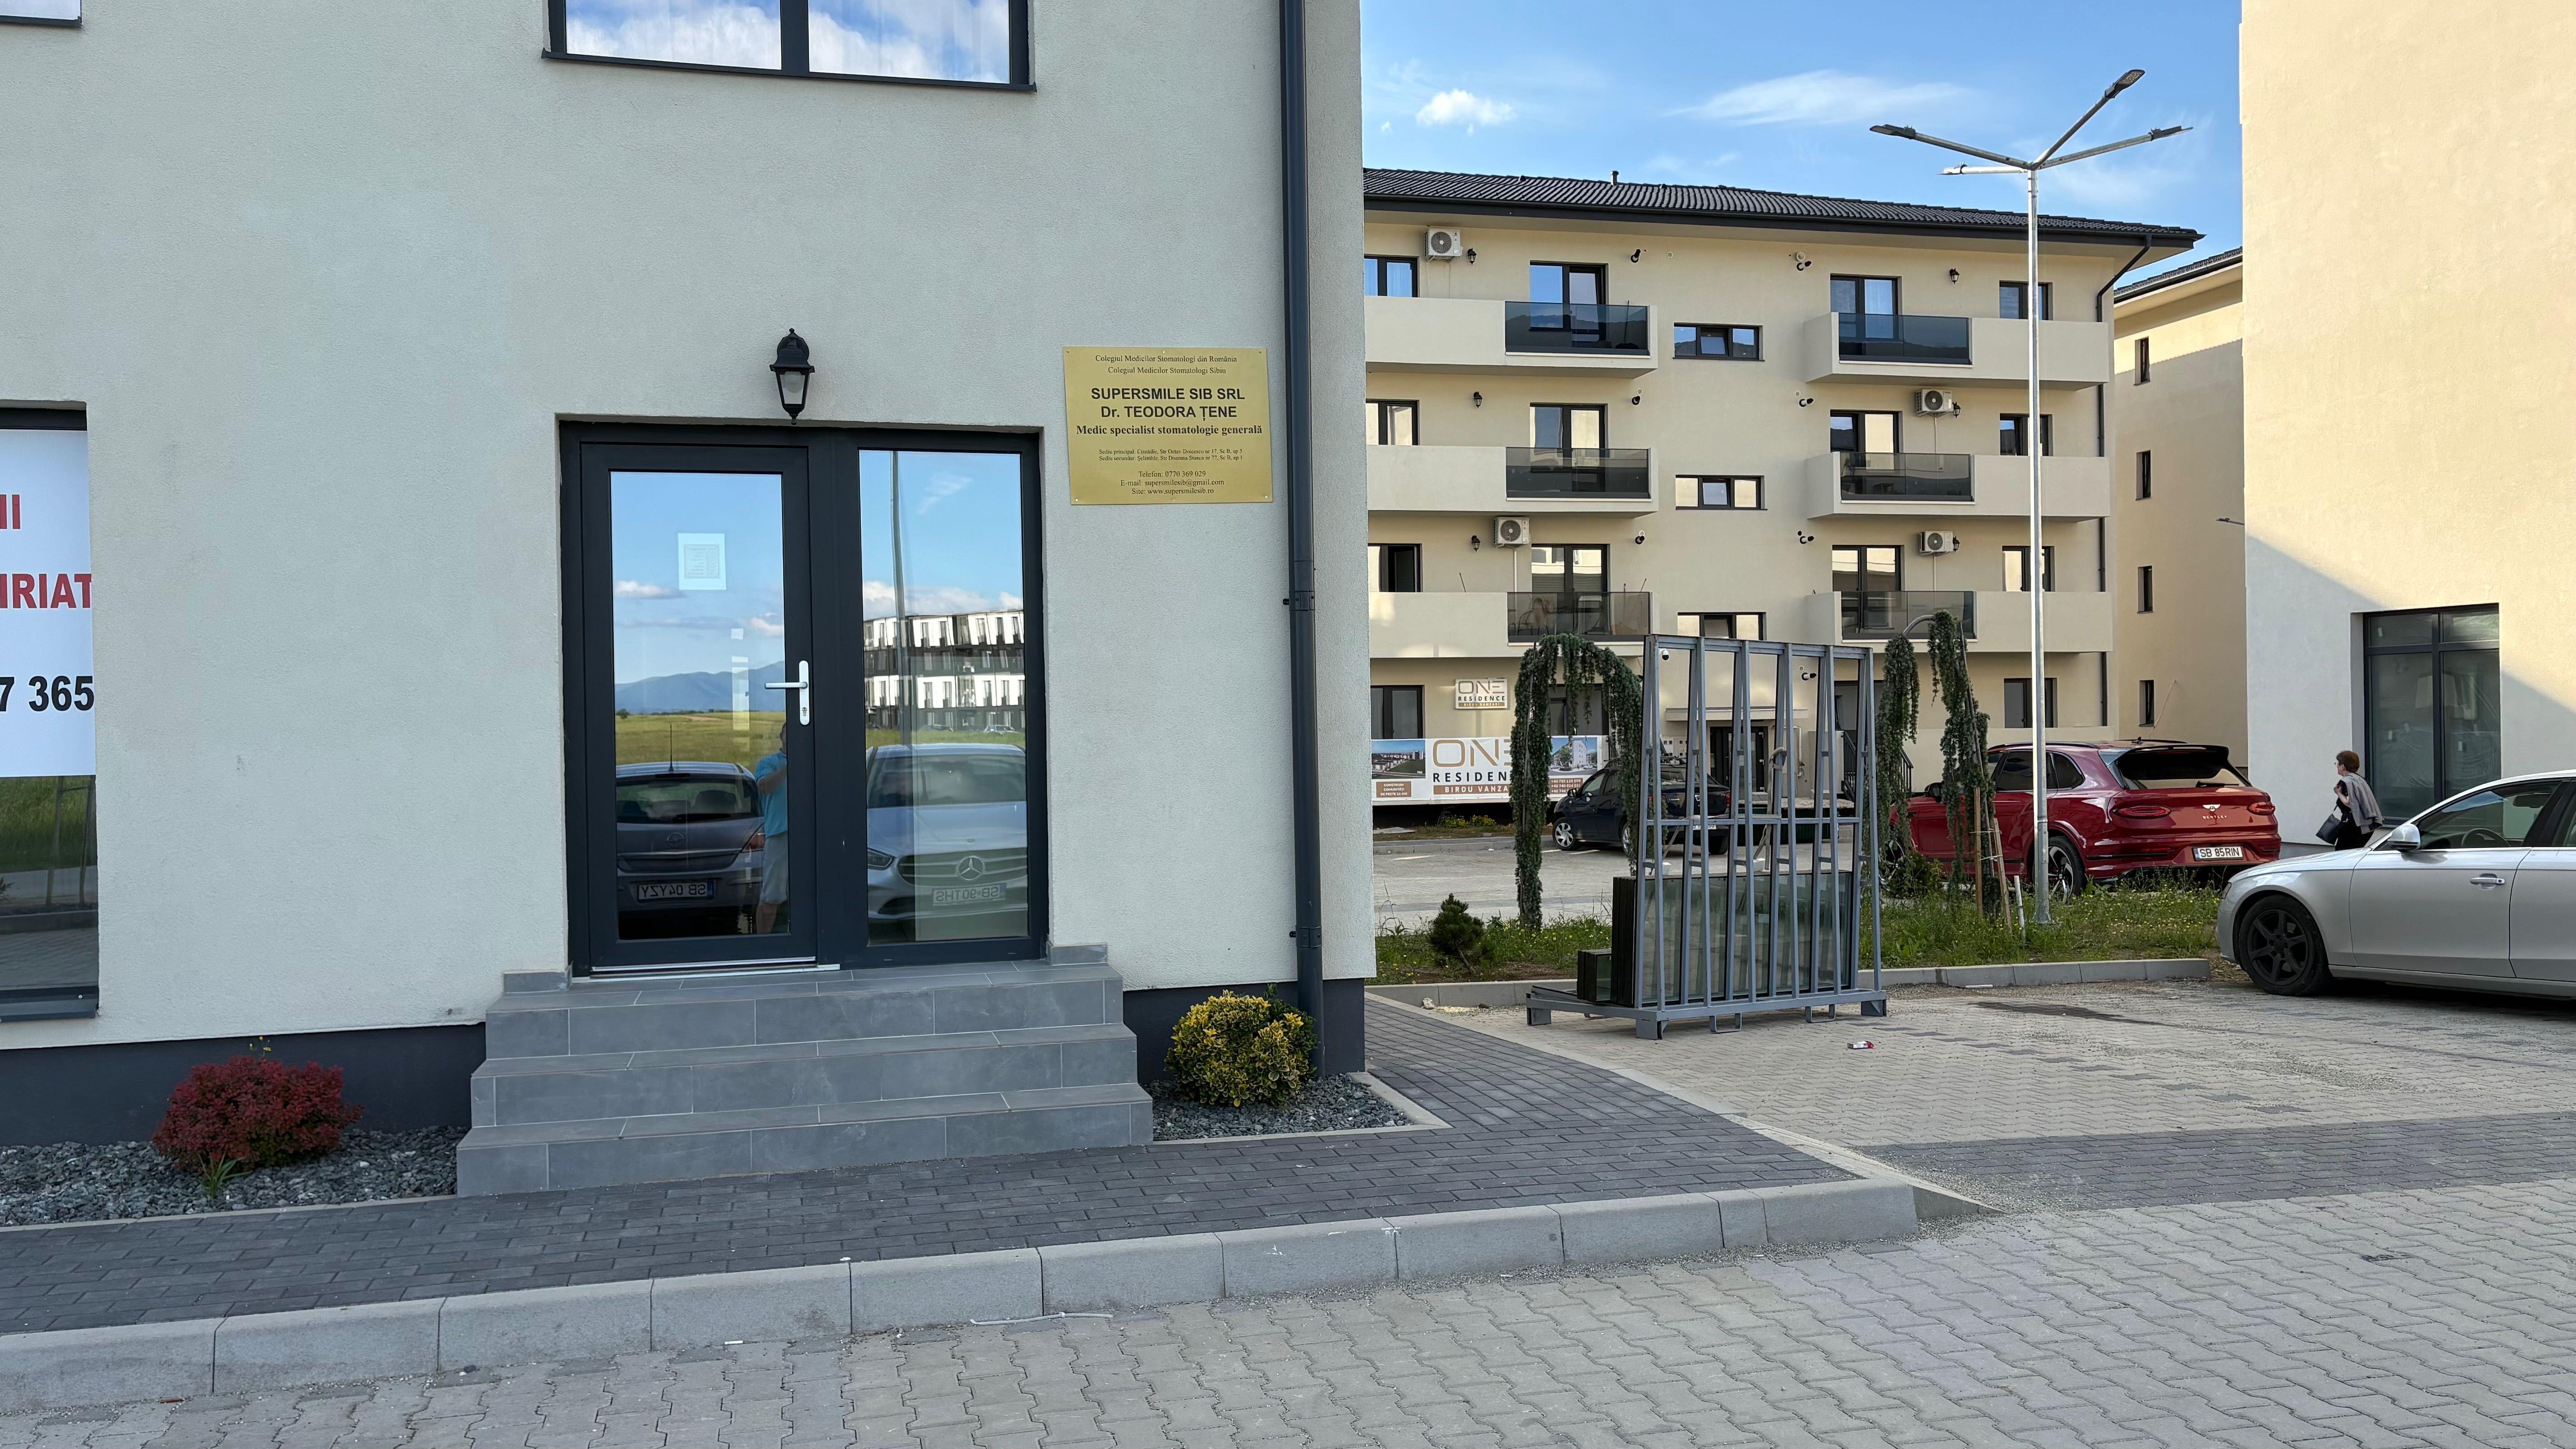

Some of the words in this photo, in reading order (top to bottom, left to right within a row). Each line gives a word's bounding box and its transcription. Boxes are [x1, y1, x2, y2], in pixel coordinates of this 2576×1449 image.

[1095, 354, 1122, 363] Colegiul
[1157, 355, 1196, 363] Stomatologi
[1108, 367, 1135, 375] Colegiul
[1091, 387, 1185, 400] SUPERSMILE
[1189, 388, 1213, 400] SIB
[1217, 388, 1245, 400] SRL
[1101, 406, 1120, 418] Dr.
[1124, 406, 1196, 418] TEODORA
[1199, 406, 1237, 422] ȚENE
[1076, 425, 1108, 434] Medic
[1110, 425, 1155, 437] specialist
[1158, 425, 1219, 437] stomatologie
[1222, 425, 1262, 437] generală
[1145, 479, 1224, 488] supersmilesib@gmail.com
[1147, 488, 1214, 496] www.supersmilesib.ro
[1458, 680, 1505, 694] ONE
[28, 675, 94, 712] 365
[1433, 771, 1507, 782] RESIDEN
[2199, 848, 2213, 857] SB
